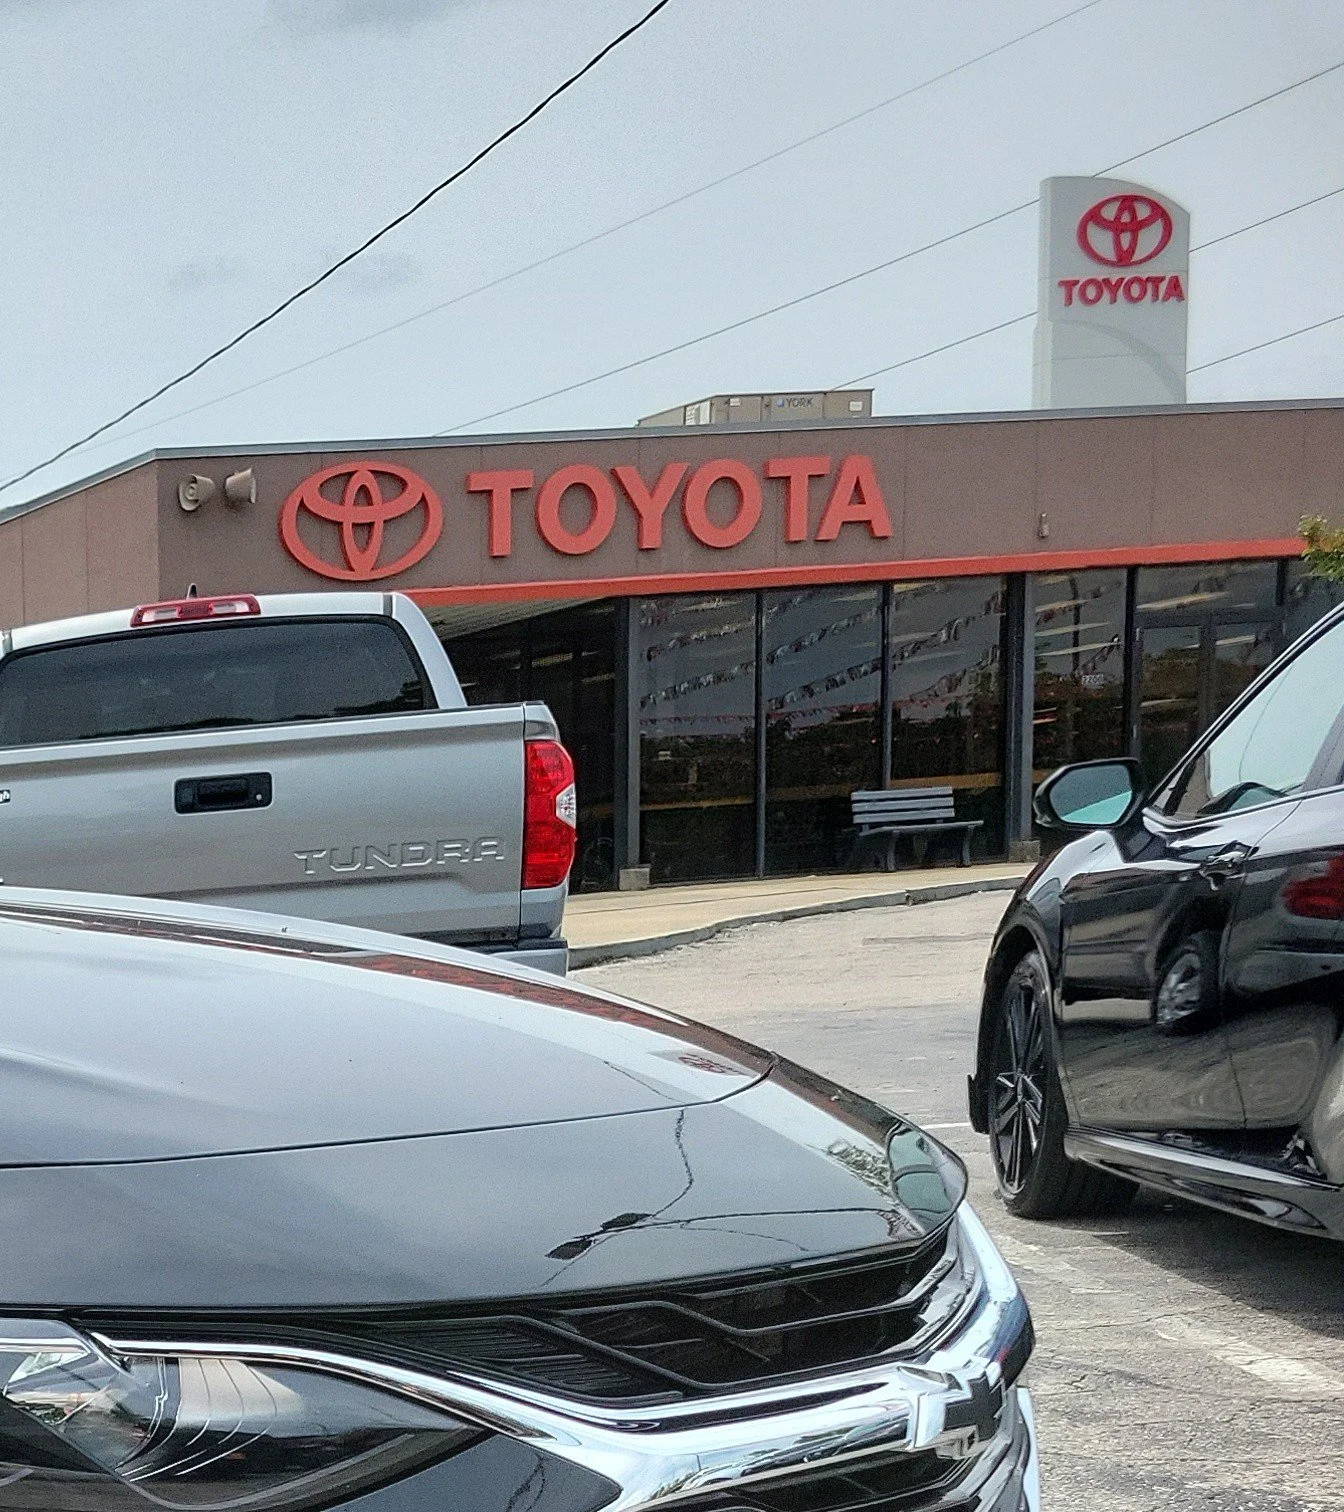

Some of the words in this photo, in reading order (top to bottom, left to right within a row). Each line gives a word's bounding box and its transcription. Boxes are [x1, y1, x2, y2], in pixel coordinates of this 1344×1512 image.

[1058, 275, 1186, 307] TOYOTA
[784, 397, 813, 409] YORK
[467, 454, 894, 558] TOYOTA
[293, 836, 505, 875] TUNDRA
